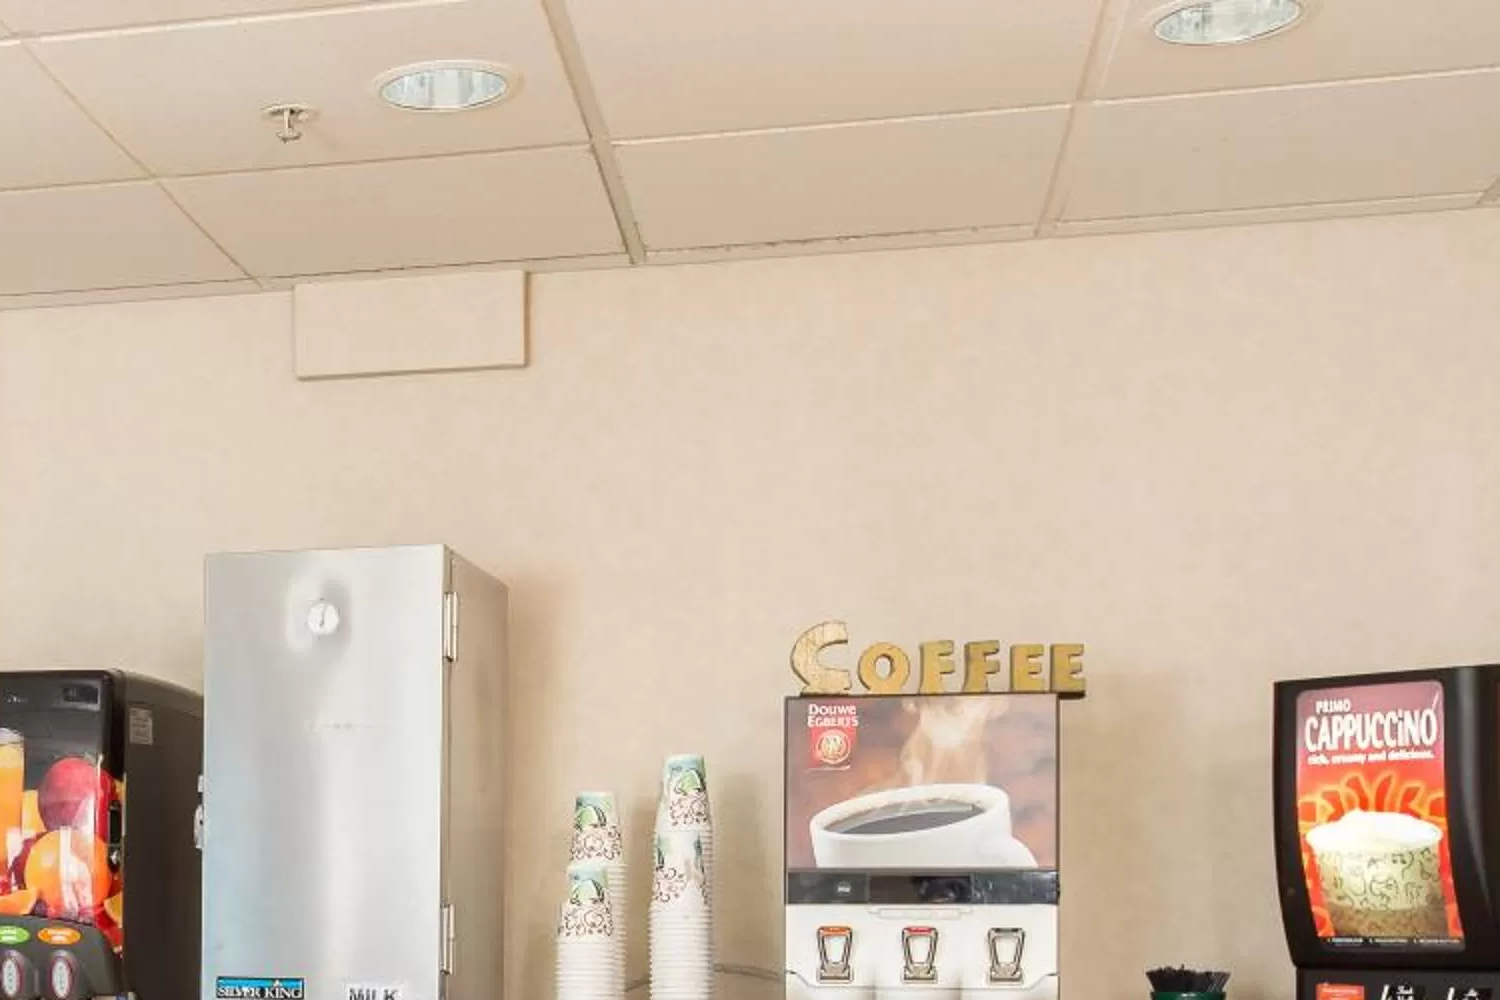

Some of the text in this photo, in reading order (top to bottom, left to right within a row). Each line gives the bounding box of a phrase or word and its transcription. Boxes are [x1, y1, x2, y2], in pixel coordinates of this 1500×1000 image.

[790, 621, 1086, 695] COFFEE
[807, 715, 859, 727] EGBERTS
[218, 984, 302, 999] SILVER KING
